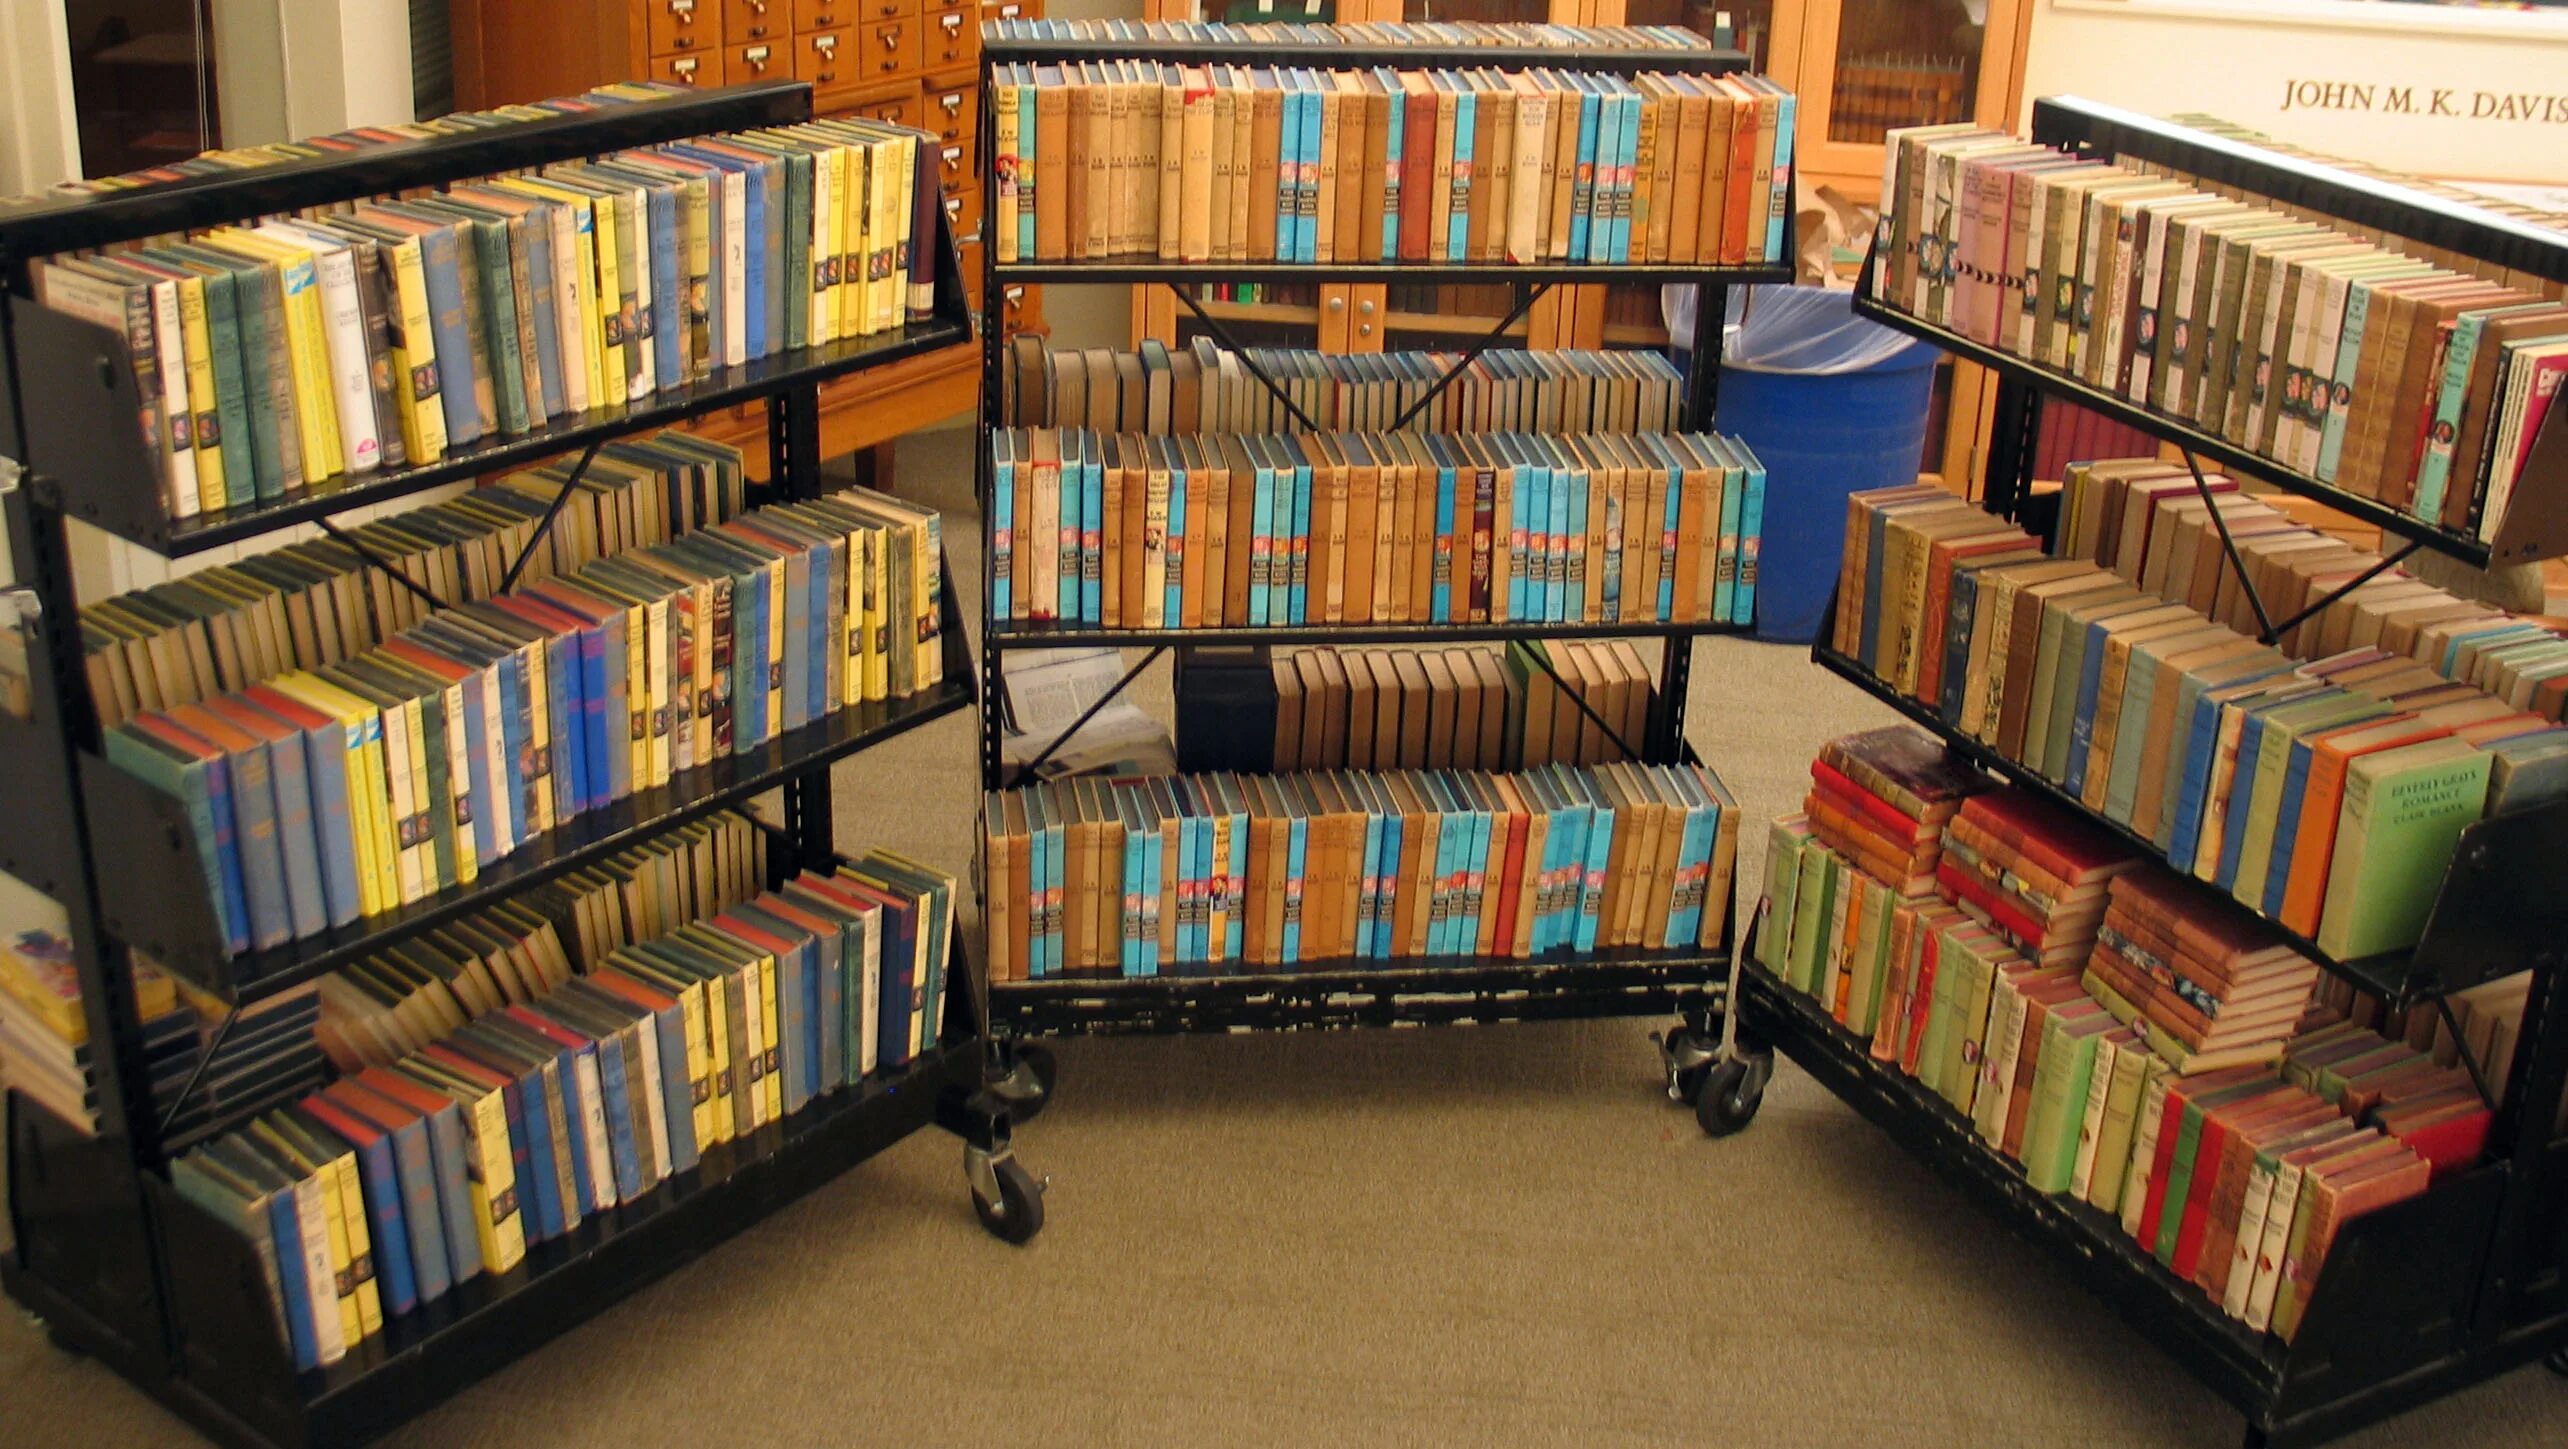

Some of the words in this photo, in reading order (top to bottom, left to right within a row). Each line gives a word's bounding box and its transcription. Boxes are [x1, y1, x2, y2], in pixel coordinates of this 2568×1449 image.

[2280, 80, 2375, 111] JOHN
[2382, 87, 2420, 114] M.
[2430, 90, 2460, 117] K.
